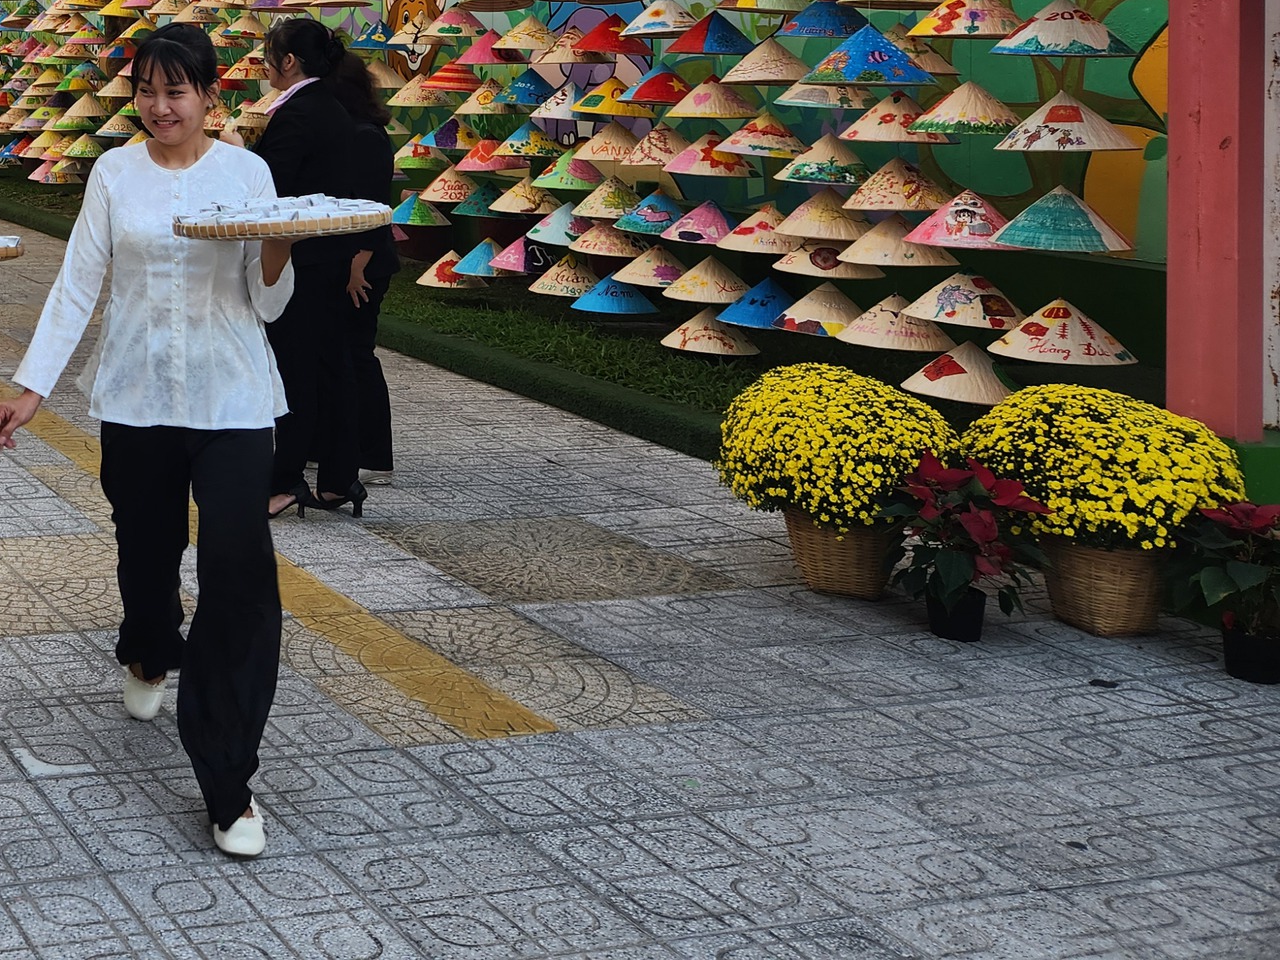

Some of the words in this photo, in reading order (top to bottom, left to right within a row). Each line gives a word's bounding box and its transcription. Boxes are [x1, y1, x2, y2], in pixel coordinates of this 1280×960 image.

[107, 123, 133, 132] 2026
[432, 178, 471, 193] Xuân
[551, 268, 593, 285] Xuân
[598, 284, 634, 298] Nam
[1027, 337, 1071, 361] Hoàng
